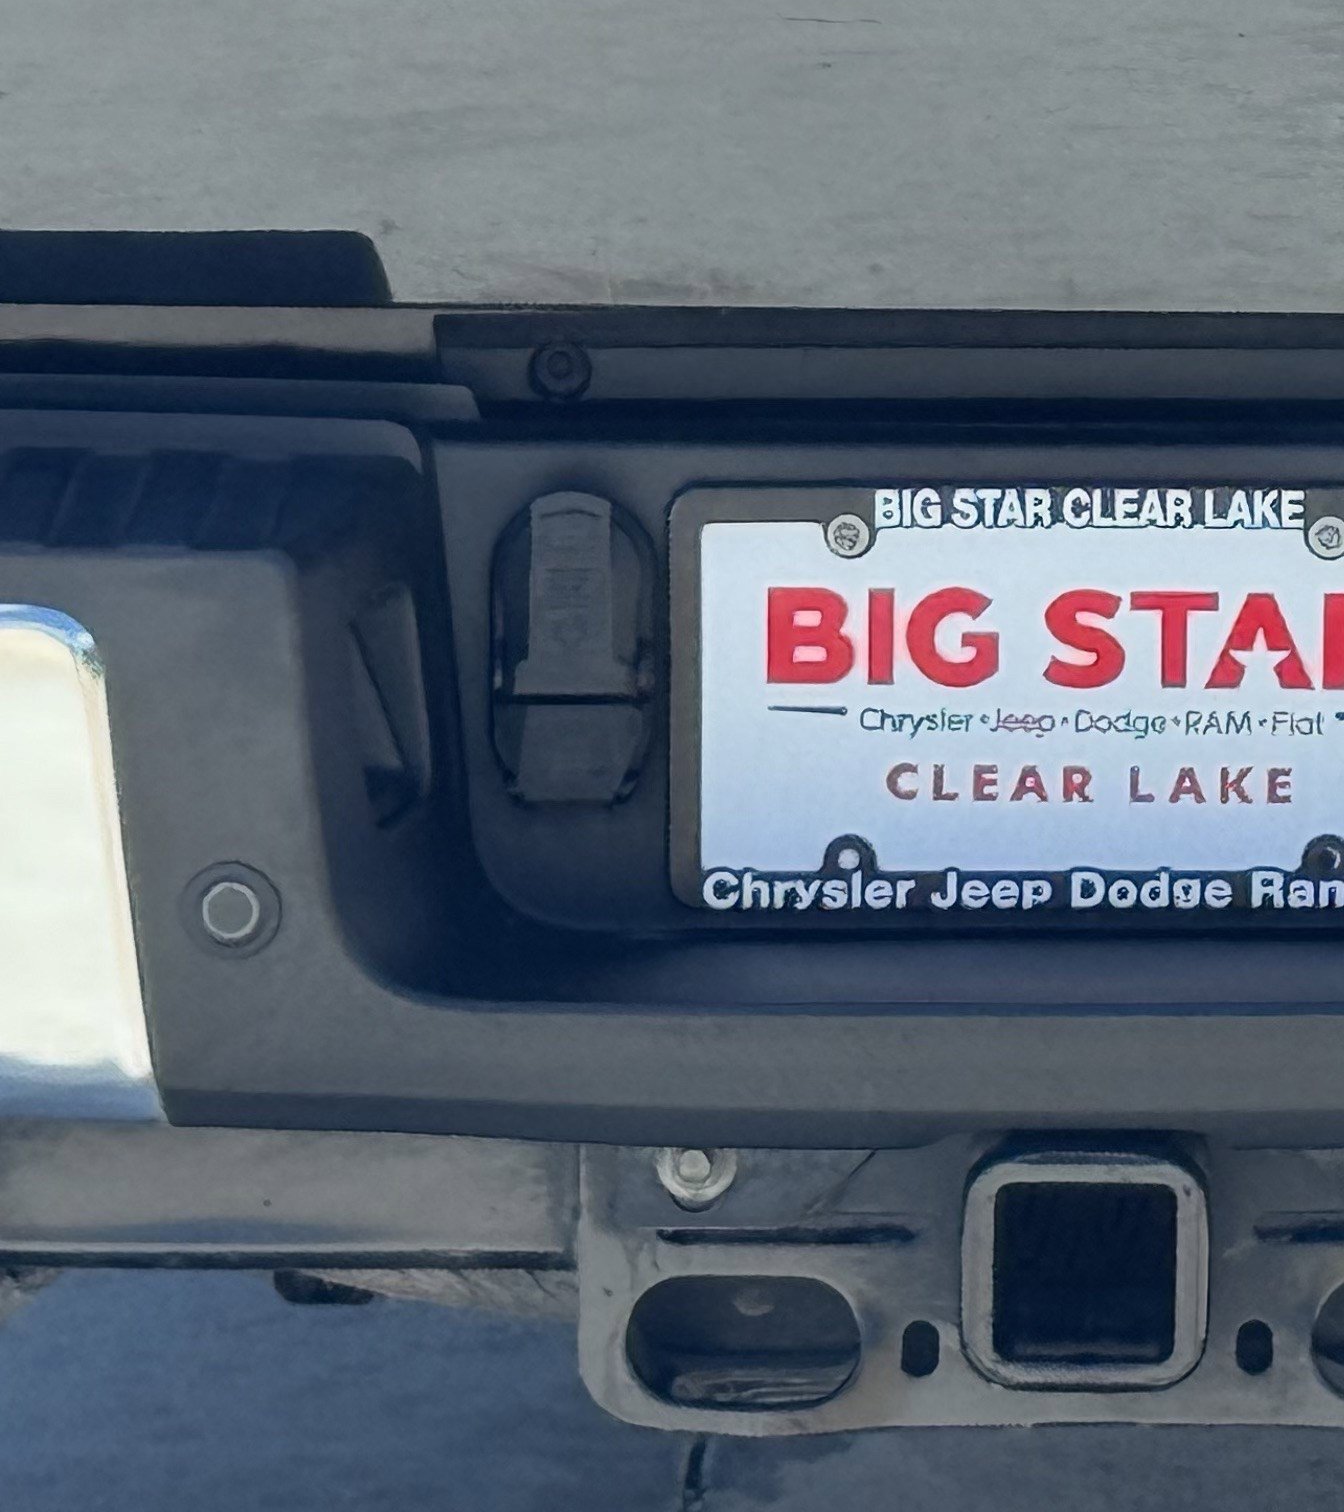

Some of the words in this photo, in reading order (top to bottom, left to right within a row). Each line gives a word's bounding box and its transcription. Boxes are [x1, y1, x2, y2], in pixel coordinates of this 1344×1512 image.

[875, 488, 942, 530] BIG
[951, 488, 1051, 530] STAR
[1063, 488, 1193, 530] CLEAR
[1204, 488, 1305, 530] LAKE
[767, 586, 1000, 688] BIG
[860, 706, 974, 739] Chrysler
[1074, 708, 1167, 740] Dodge
[1185, 709, 1253, 736] RAM
[1271, 710, 1325, 737] Fiat
[886, 762, 1095, 803] CLEAR
[1129, 764, 1293, 805] LAKE
[702, 869, 916, 911] Chrysler
[930, 869, 1053, 911] Jeep
[1071, 870, 1234, 910] Dodge
